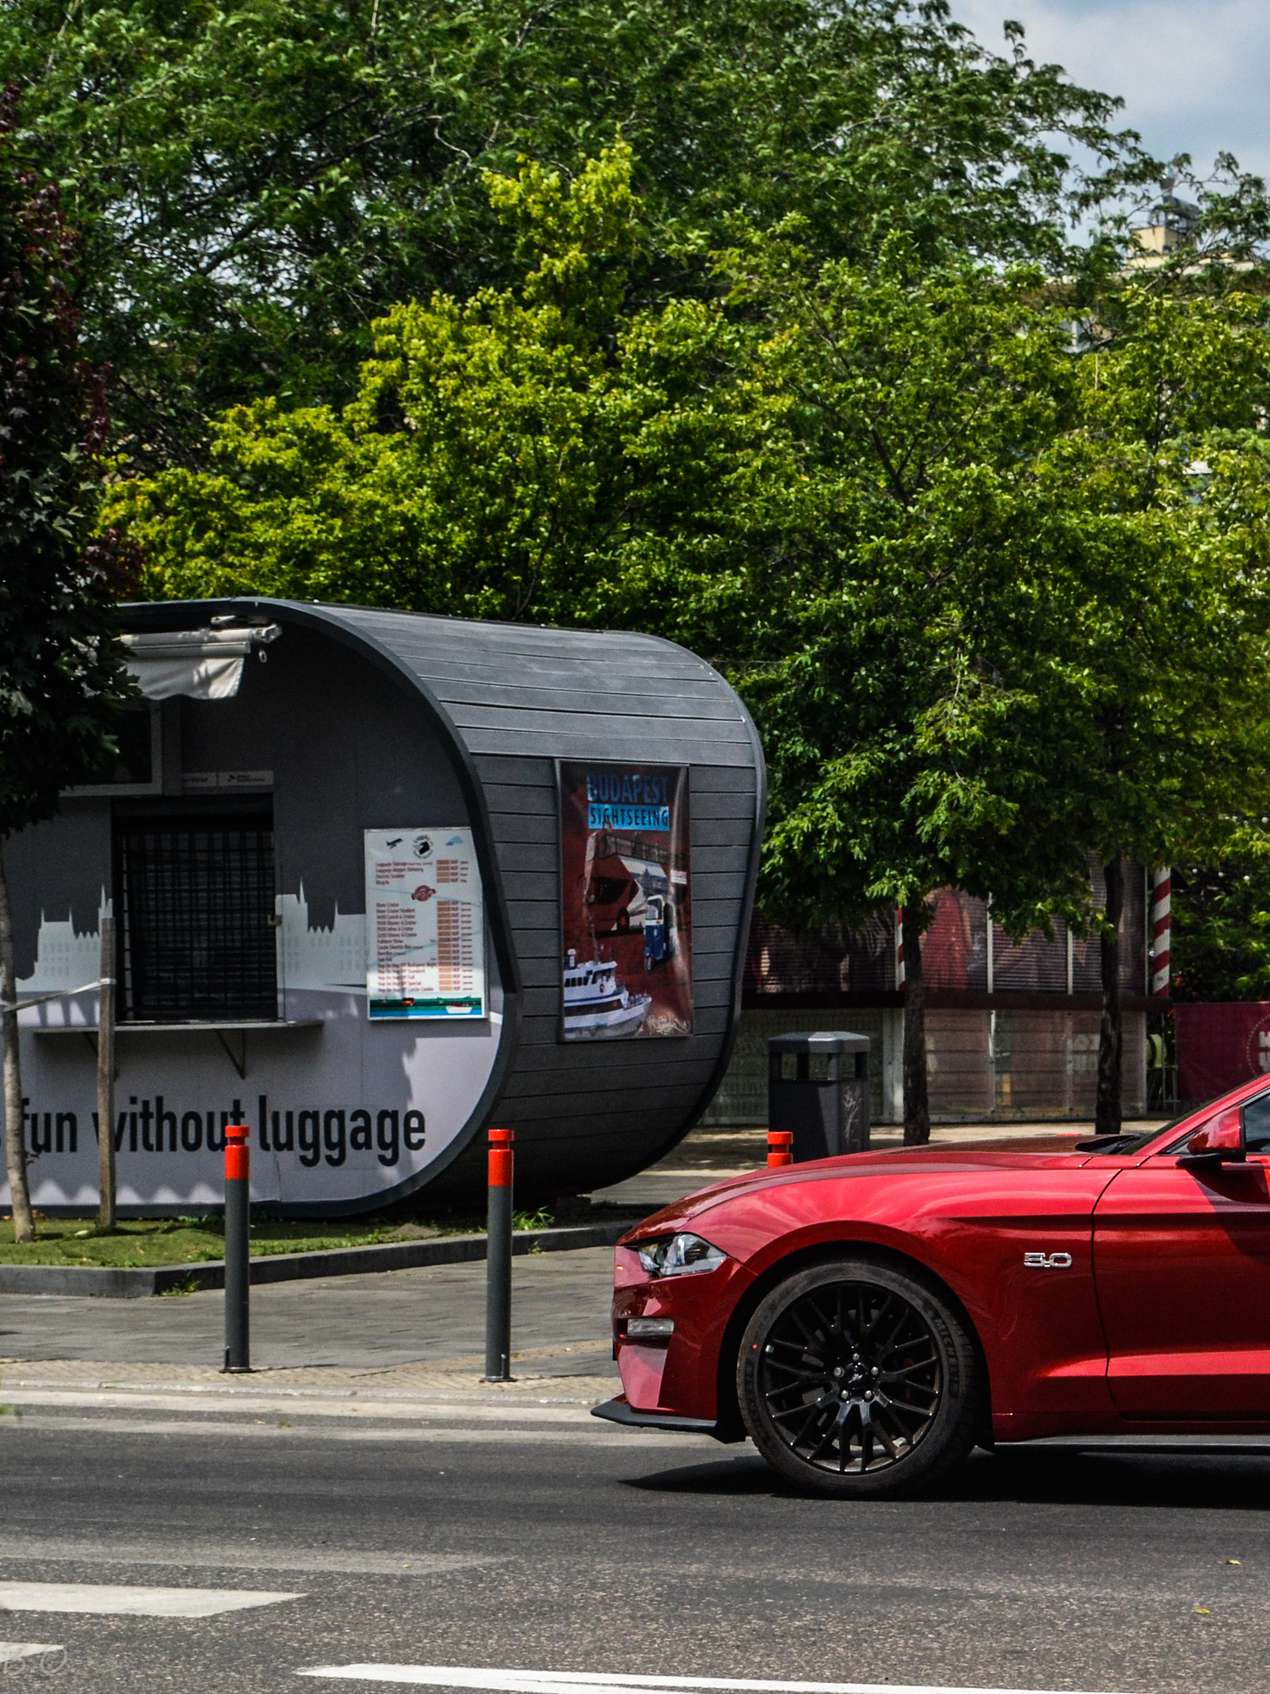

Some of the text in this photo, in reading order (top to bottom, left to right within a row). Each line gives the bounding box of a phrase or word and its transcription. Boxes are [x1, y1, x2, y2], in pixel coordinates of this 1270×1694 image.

[587, 772, 668, 804] BUDAPEST
[590, 807, 669, 827] SIGHTSEEING
[258, 1095, 426, 1167] luggage
[1023, 1252, 1073, 1268] 5.0
